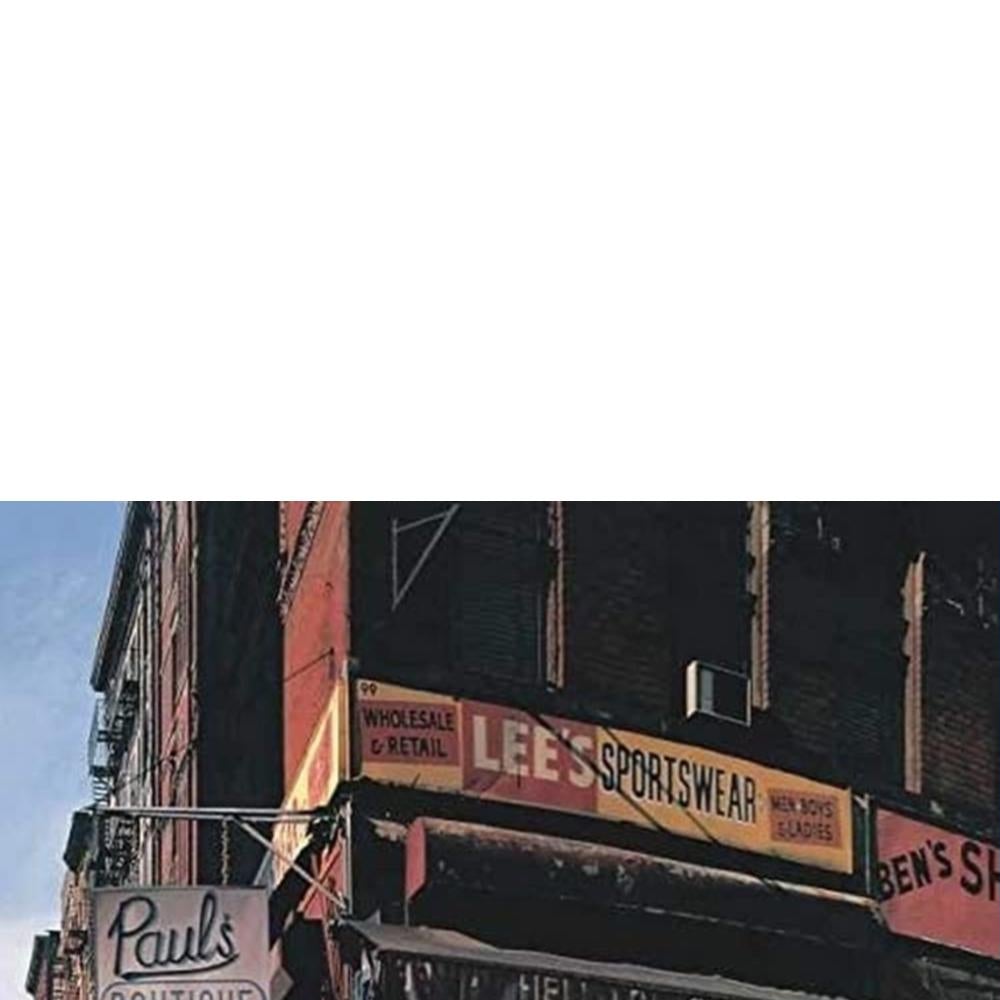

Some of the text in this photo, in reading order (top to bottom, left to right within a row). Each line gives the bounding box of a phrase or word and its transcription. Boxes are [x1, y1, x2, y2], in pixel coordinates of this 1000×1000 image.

[360, 682, 378, 697] 99
[362, 707, 454, 731] WHOLESALE
[387, 735, 447, 757] RETAIL
[472, 714, 595, 789] LEE'S
[601, 741, 757, 824] SPORTSWEAR
[877, 839, 951, 901] BEN'S
